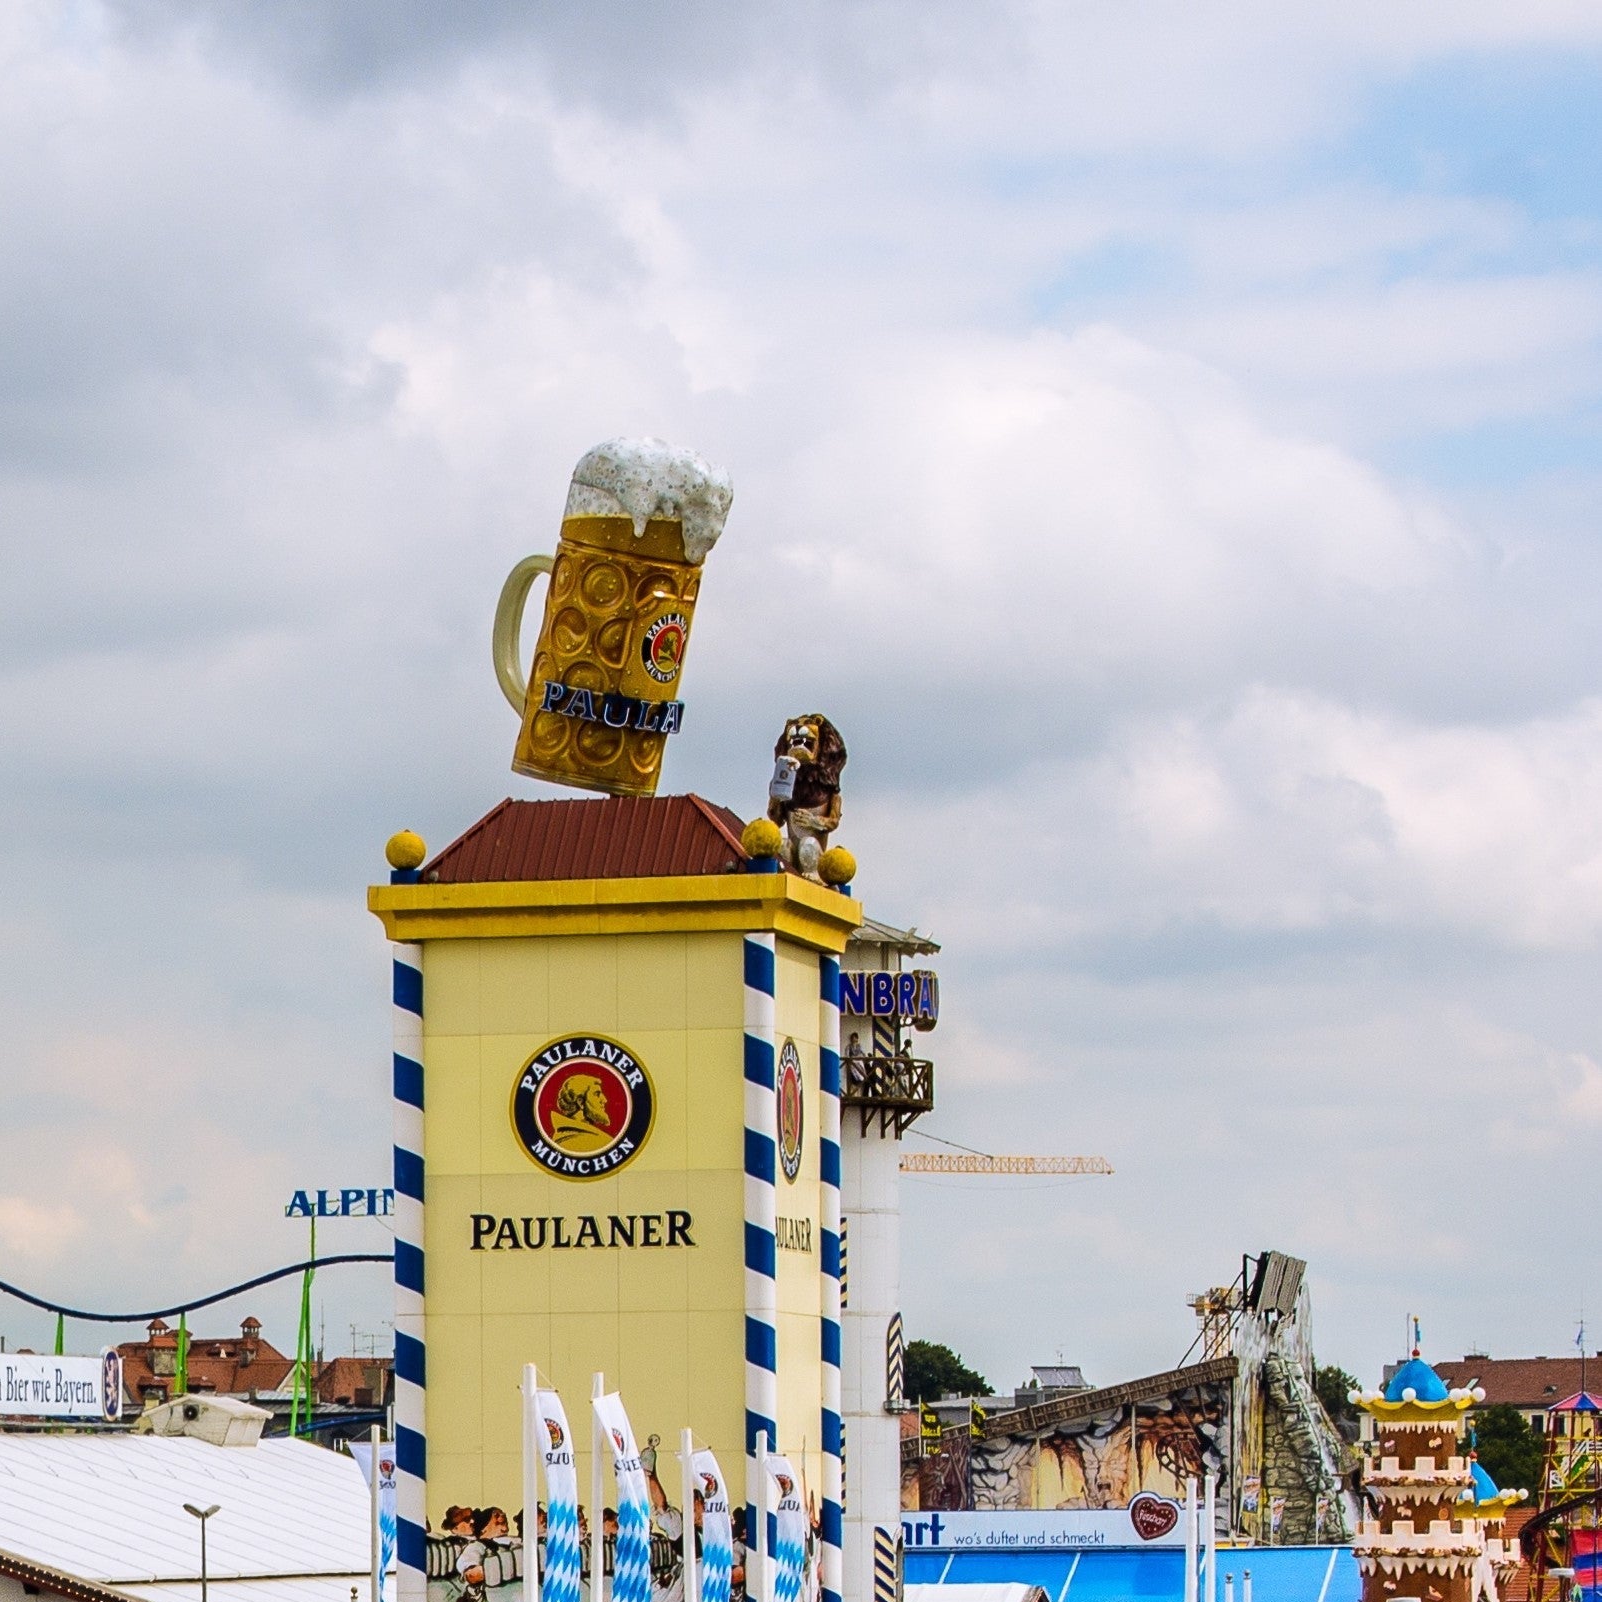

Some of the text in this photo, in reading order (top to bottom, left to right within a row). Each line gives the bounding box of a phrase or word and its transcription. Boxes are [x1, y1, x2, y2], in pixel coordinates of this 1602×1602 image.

[647, 614, 687, 641] PAULAN
[540, 681, 684, 734] PAULA
[839, 970, 939, 1020] NBRÄ
[520, 1039, 645, 1093] PAULANER
[530, 1136, 636, 1174] MÜNCHEN
[469, 1210, 697, 1251] PAULANER
[6, 1366, 29, 1403] Bier
[32, 1366, 51, 1403] wie
[54, 1368, 97, 1413] Bayern.
[954, 1531, 982, 1545] wo's
[986, 1530, 1019, 1545] duftet
[1023, 1530, 1045, 1545] und
[1050, 1530, 1105, 1545] schmeckt
